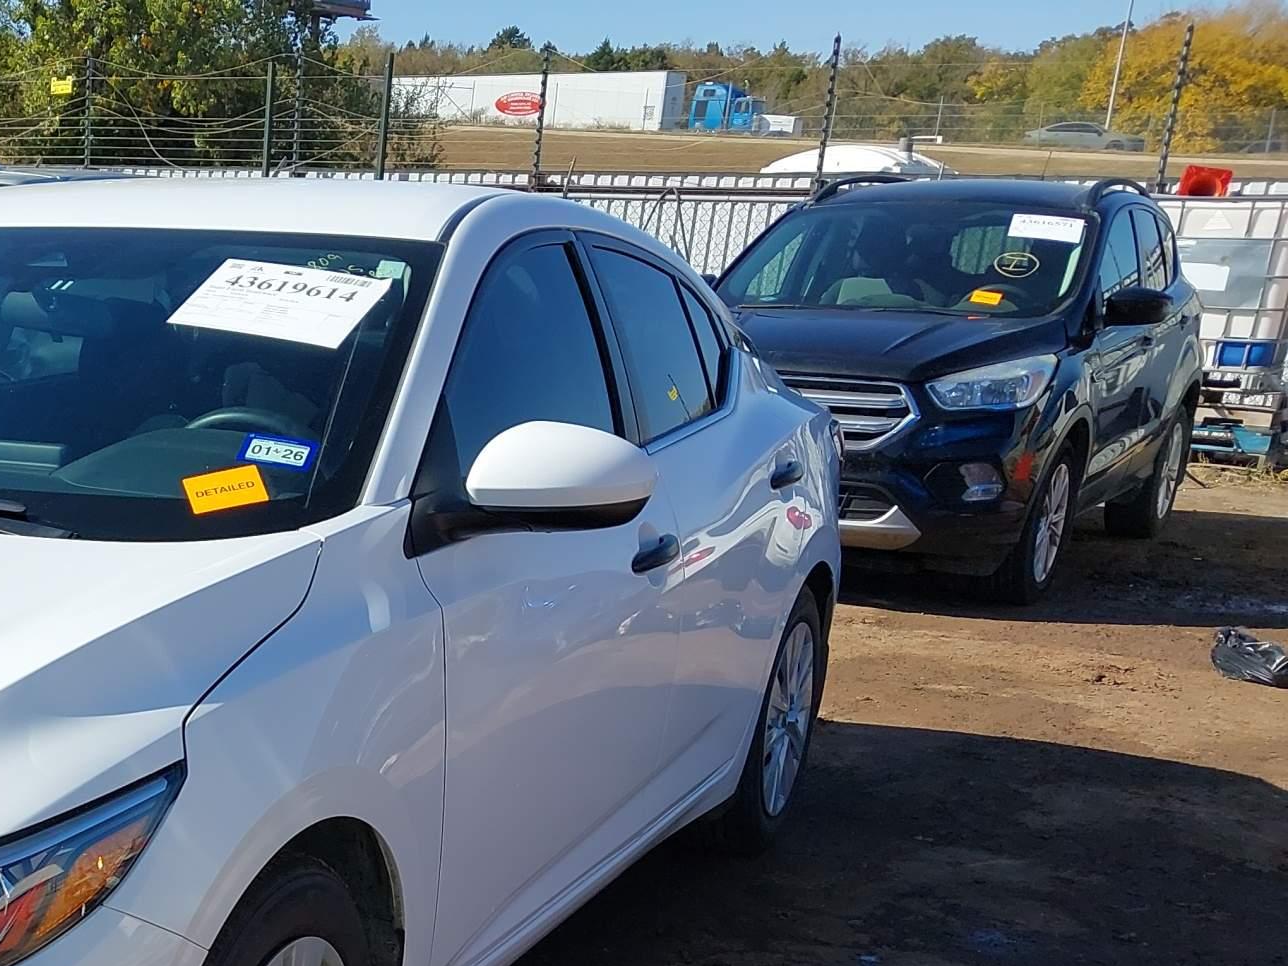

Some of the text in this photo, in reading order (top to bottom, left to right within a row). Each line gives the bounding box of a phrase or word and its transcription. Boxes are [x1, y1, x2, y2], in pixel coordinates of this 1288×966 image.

[224, 274, 360, 303] 43619614
[251, 444, 272, 456] 01
[281, 448, 305, 461] 26
[195, 480, 256, 498] DETAILED
